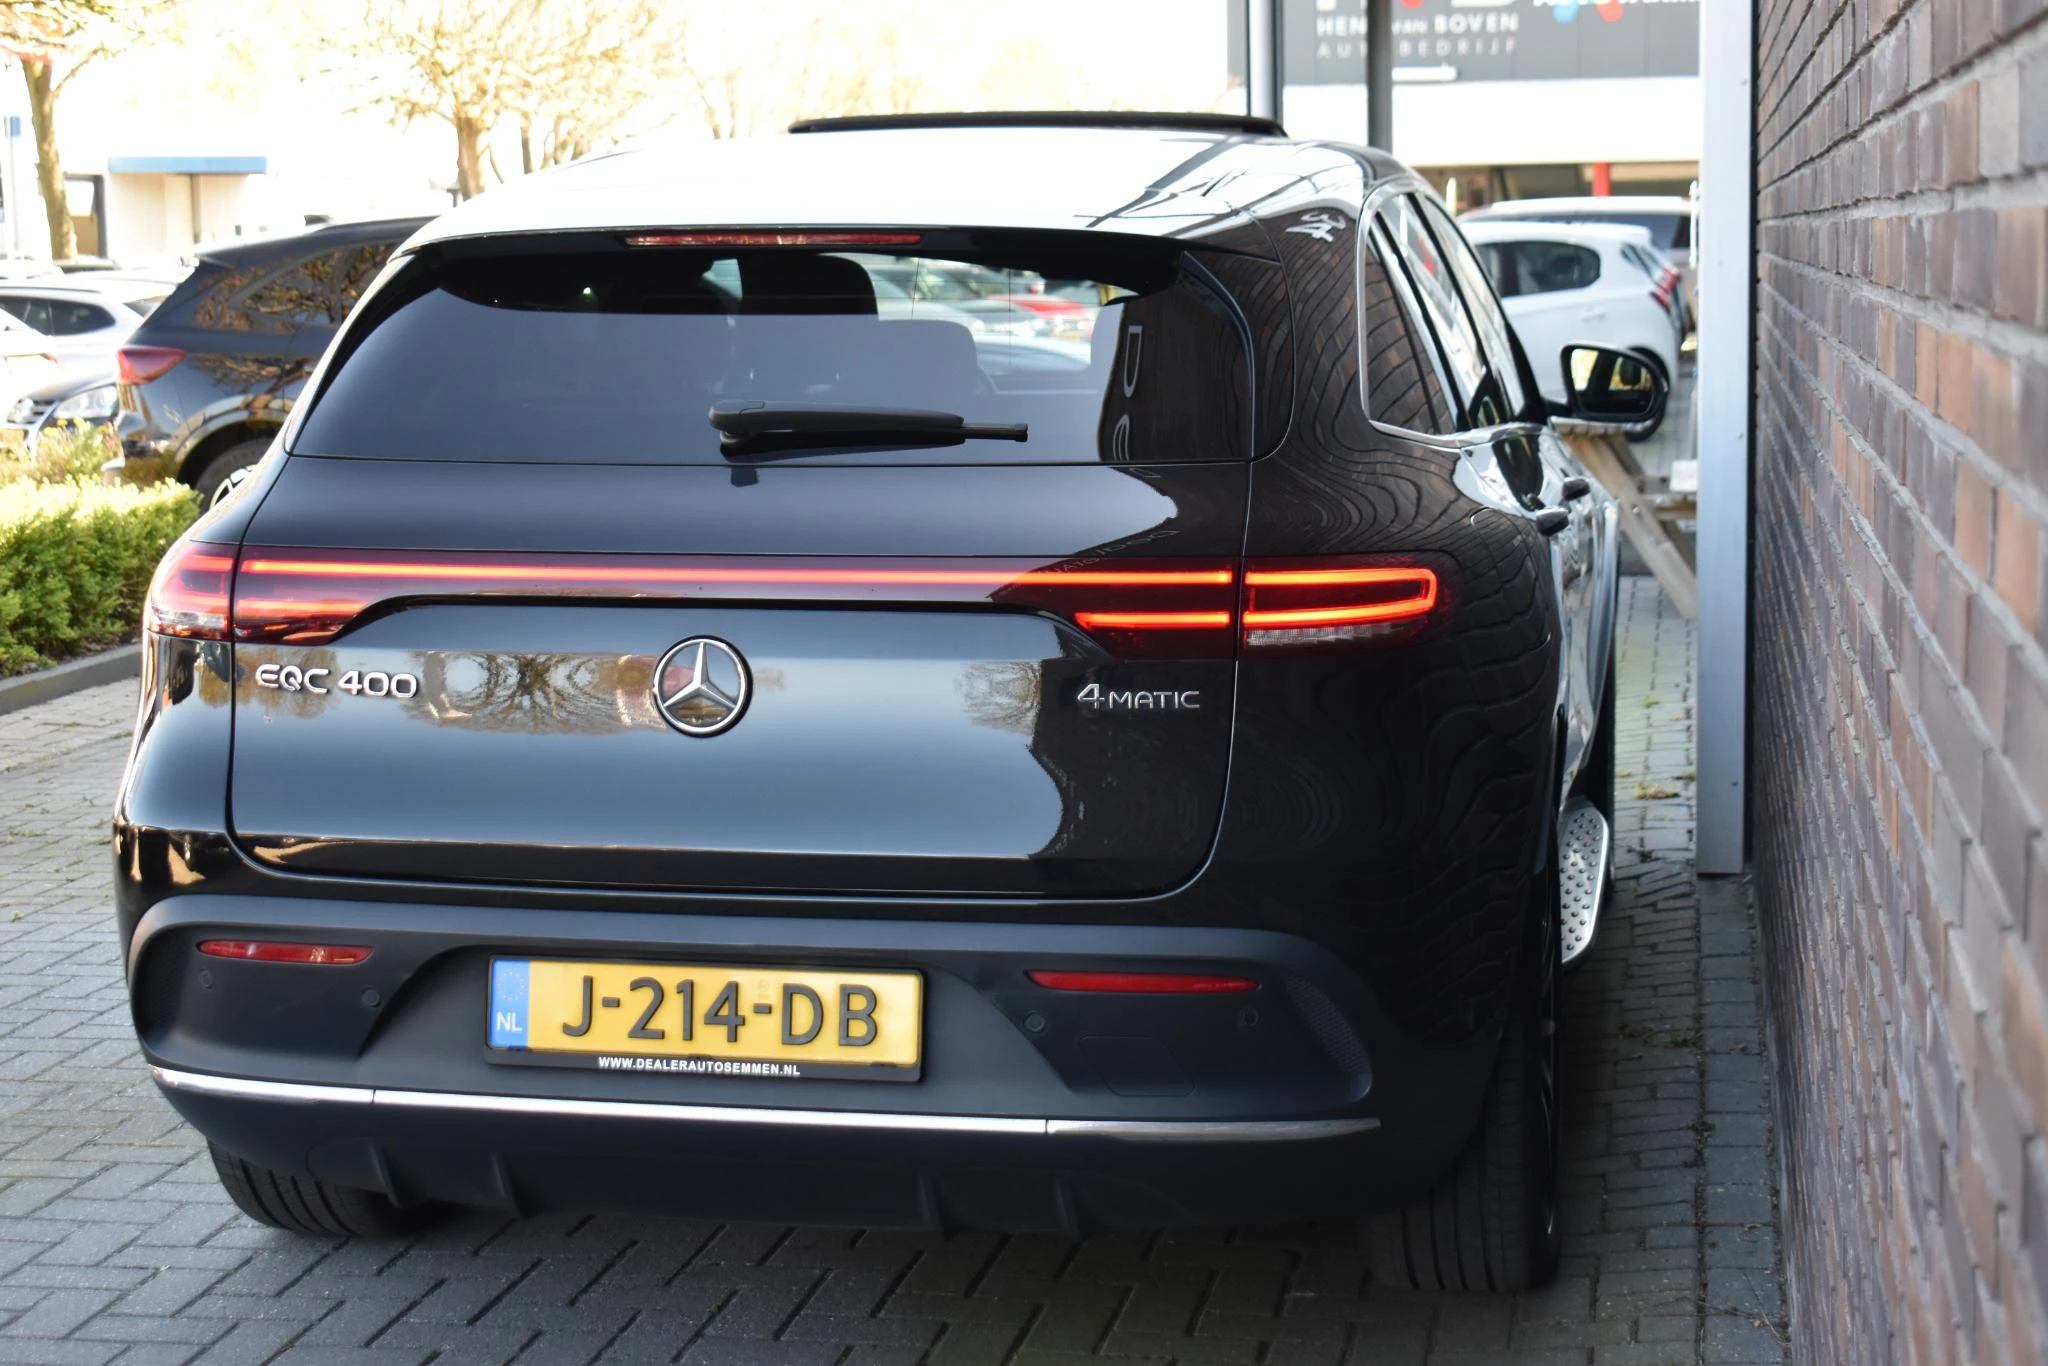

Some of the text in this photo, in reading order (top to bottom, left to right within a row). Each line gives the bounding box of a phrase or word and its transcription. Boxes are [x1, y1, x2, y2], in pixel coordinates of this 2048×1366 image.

[1316, 15, 1368, 37] HEN
[1434, 12, 1519, 34] BOVEN
[255, 663, 418, 698] EQC 400
[1077, 683, 1201, 709] 4MATIC
[495, 1011, 523, 1033] NL
[562, 975, 878, 1047] J-214-DB
[598, 1056, 801, 1076] WWW.DEALERAUTOSEMMEN.NL
